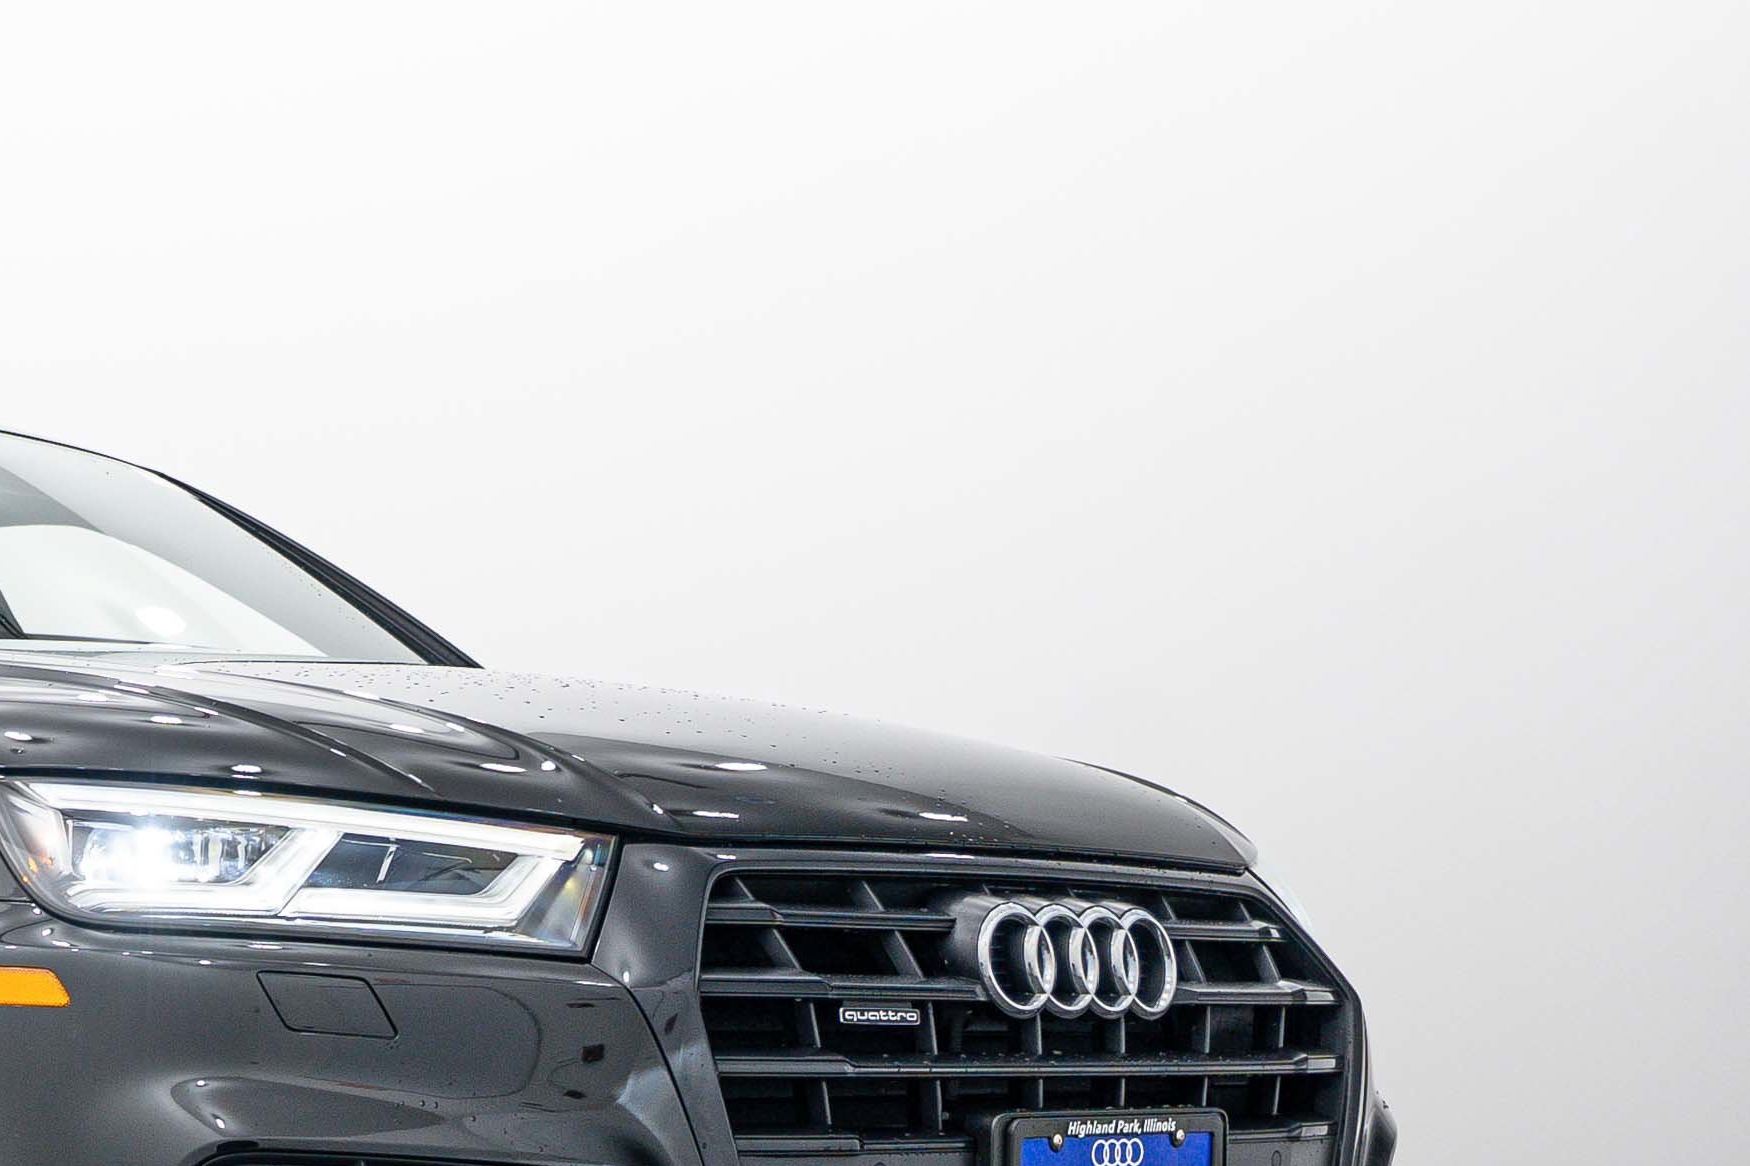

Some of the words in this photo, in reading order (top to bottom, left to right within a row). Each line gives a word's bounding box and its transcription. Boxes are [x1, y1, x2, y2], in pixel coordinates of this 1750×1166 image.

[844, 1010, 918, 1021] quattro
[1068, 1120, 1116, 1138] Highland
[1117, 1119, 1142, 1134] Park,
[1143, 1117, 1177, 1133] Illinois
